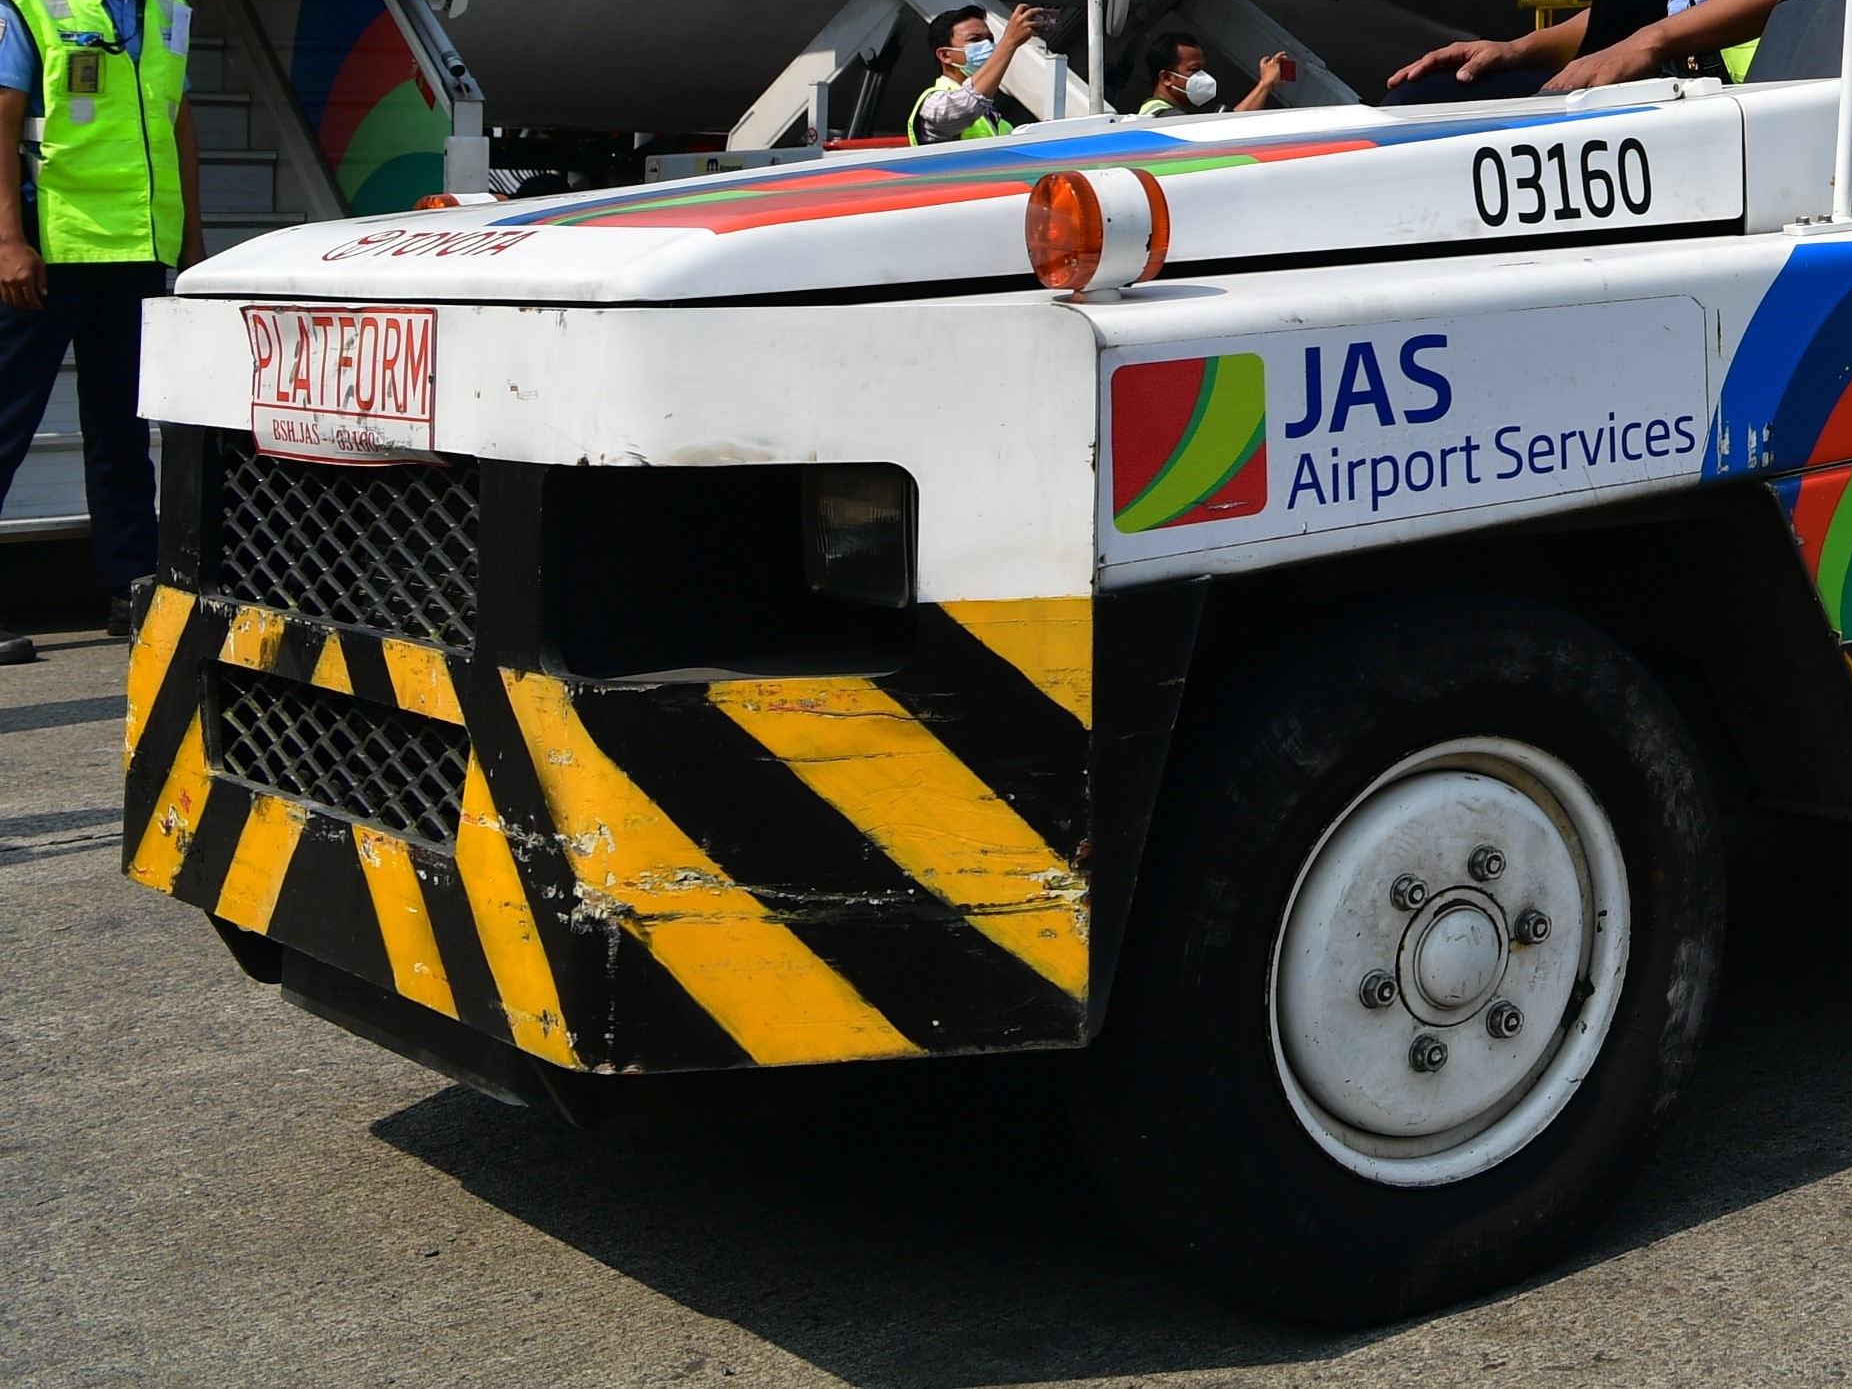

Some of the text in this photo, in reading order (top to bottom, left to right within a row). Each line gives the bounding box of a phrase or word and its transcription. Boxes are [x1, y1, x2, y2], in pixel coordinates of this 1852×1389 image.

[1471, 136, 1653, 228] 03160
[380, 230, 540, 257] TOYOTA
[252, 313, 430, 416] PLATFORM
[1284, 333, 1453, 439] JAS
[1286, 411, 1697, 512] Airport Services
